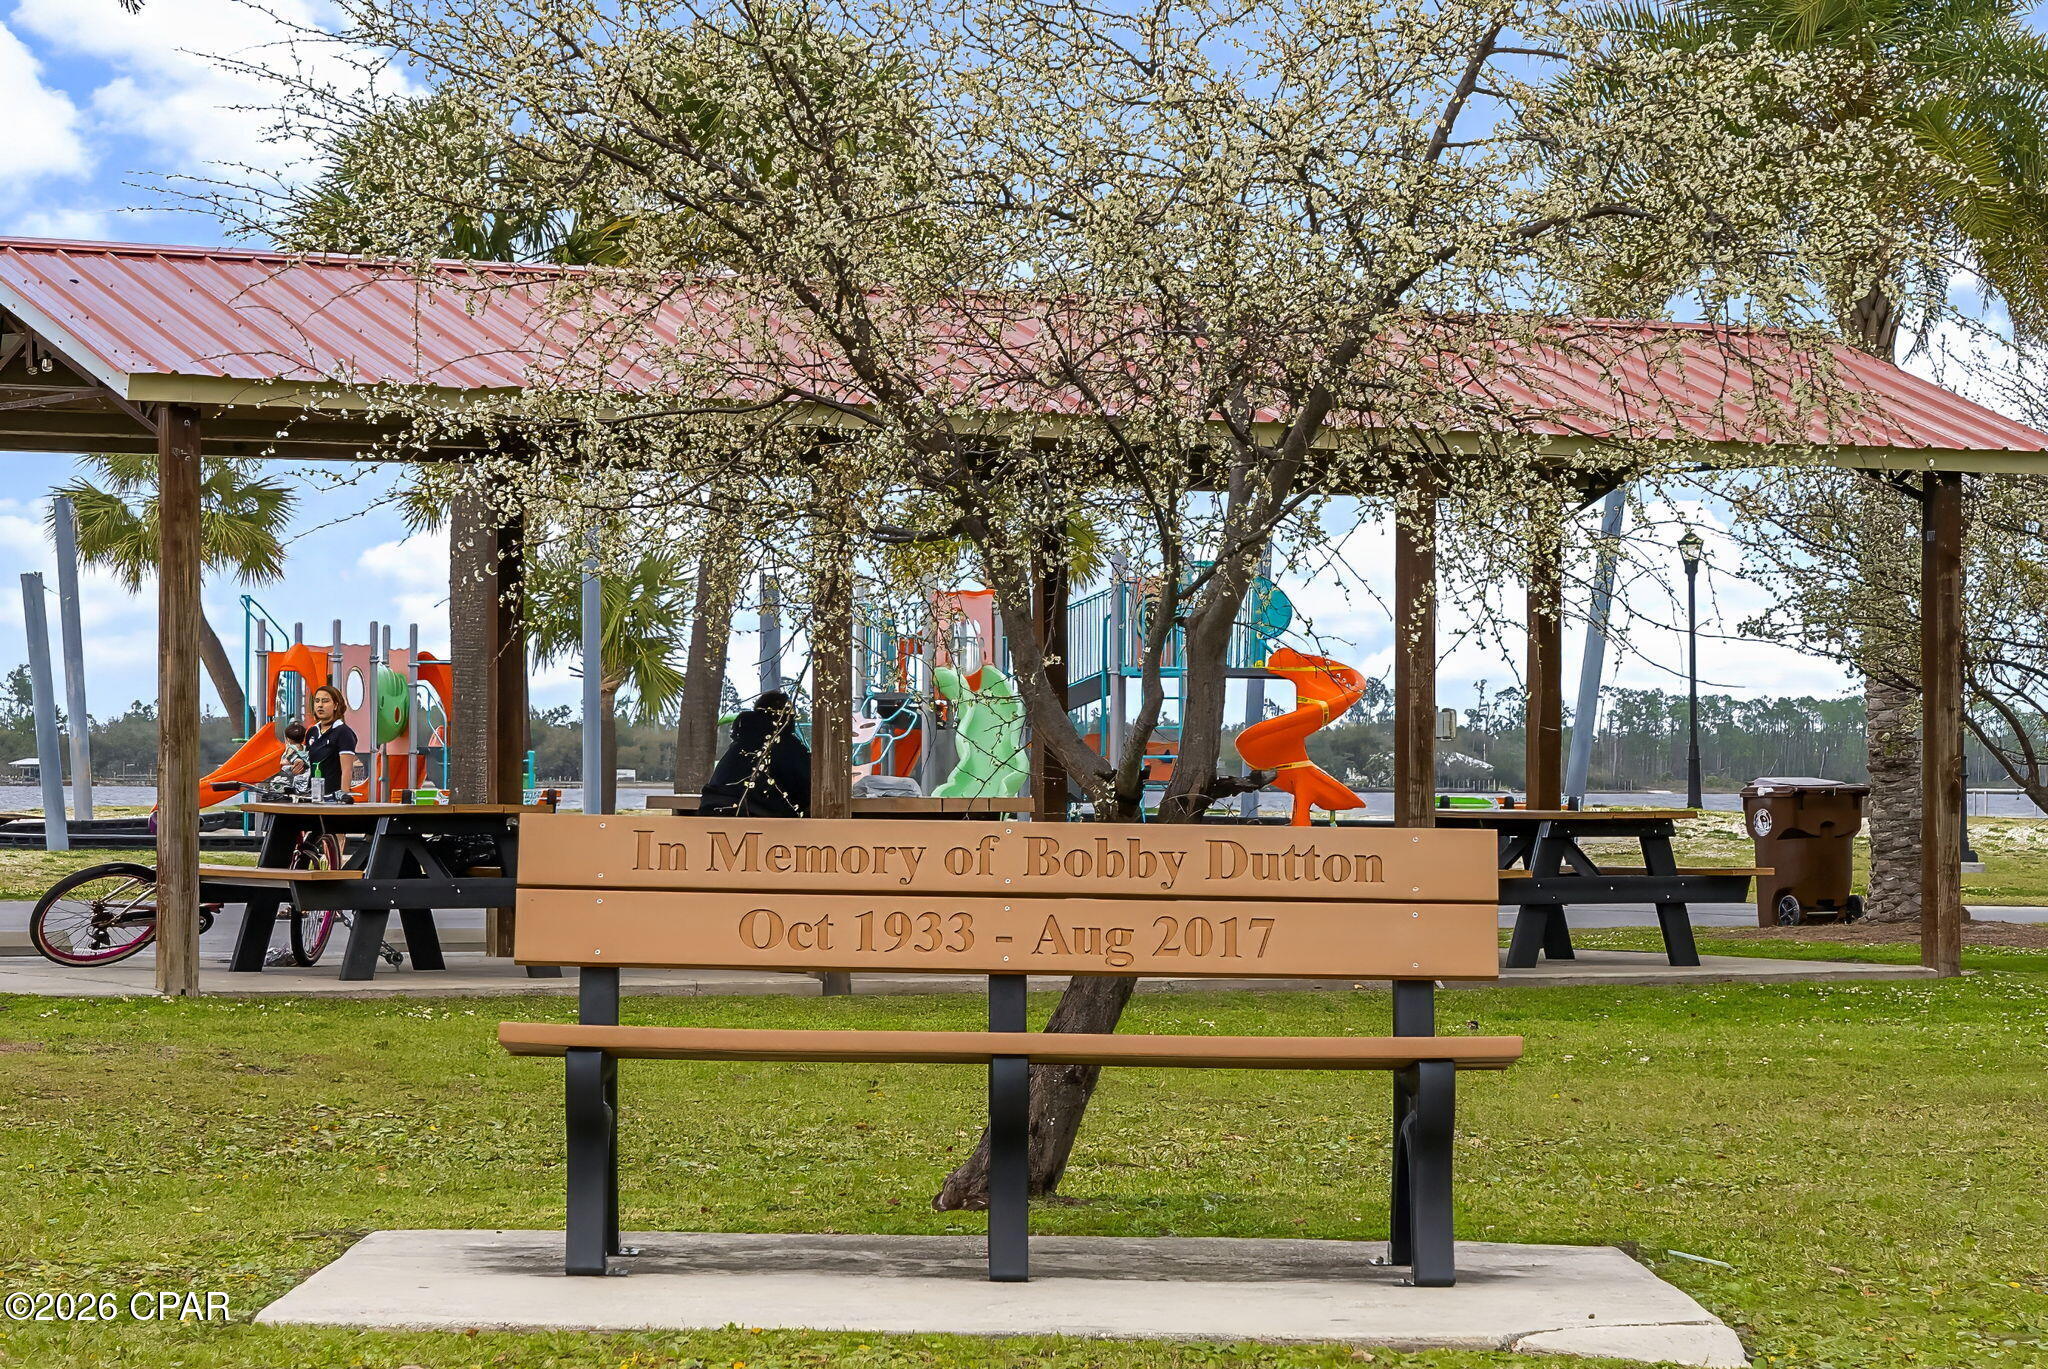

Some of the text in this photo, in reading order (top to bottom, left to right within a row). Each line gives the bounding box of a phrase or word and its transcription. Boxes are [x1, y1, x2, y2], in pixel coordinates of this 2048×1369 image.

[632, 829, 1384, 890] In Memory of Bobby Dutton
[738, 908, 834, 951] Oct
[855, 910, 975, 952] 1933
[1031, 914, 1134, 967] Aug
[1152, 915, 1275, 958] 2017
